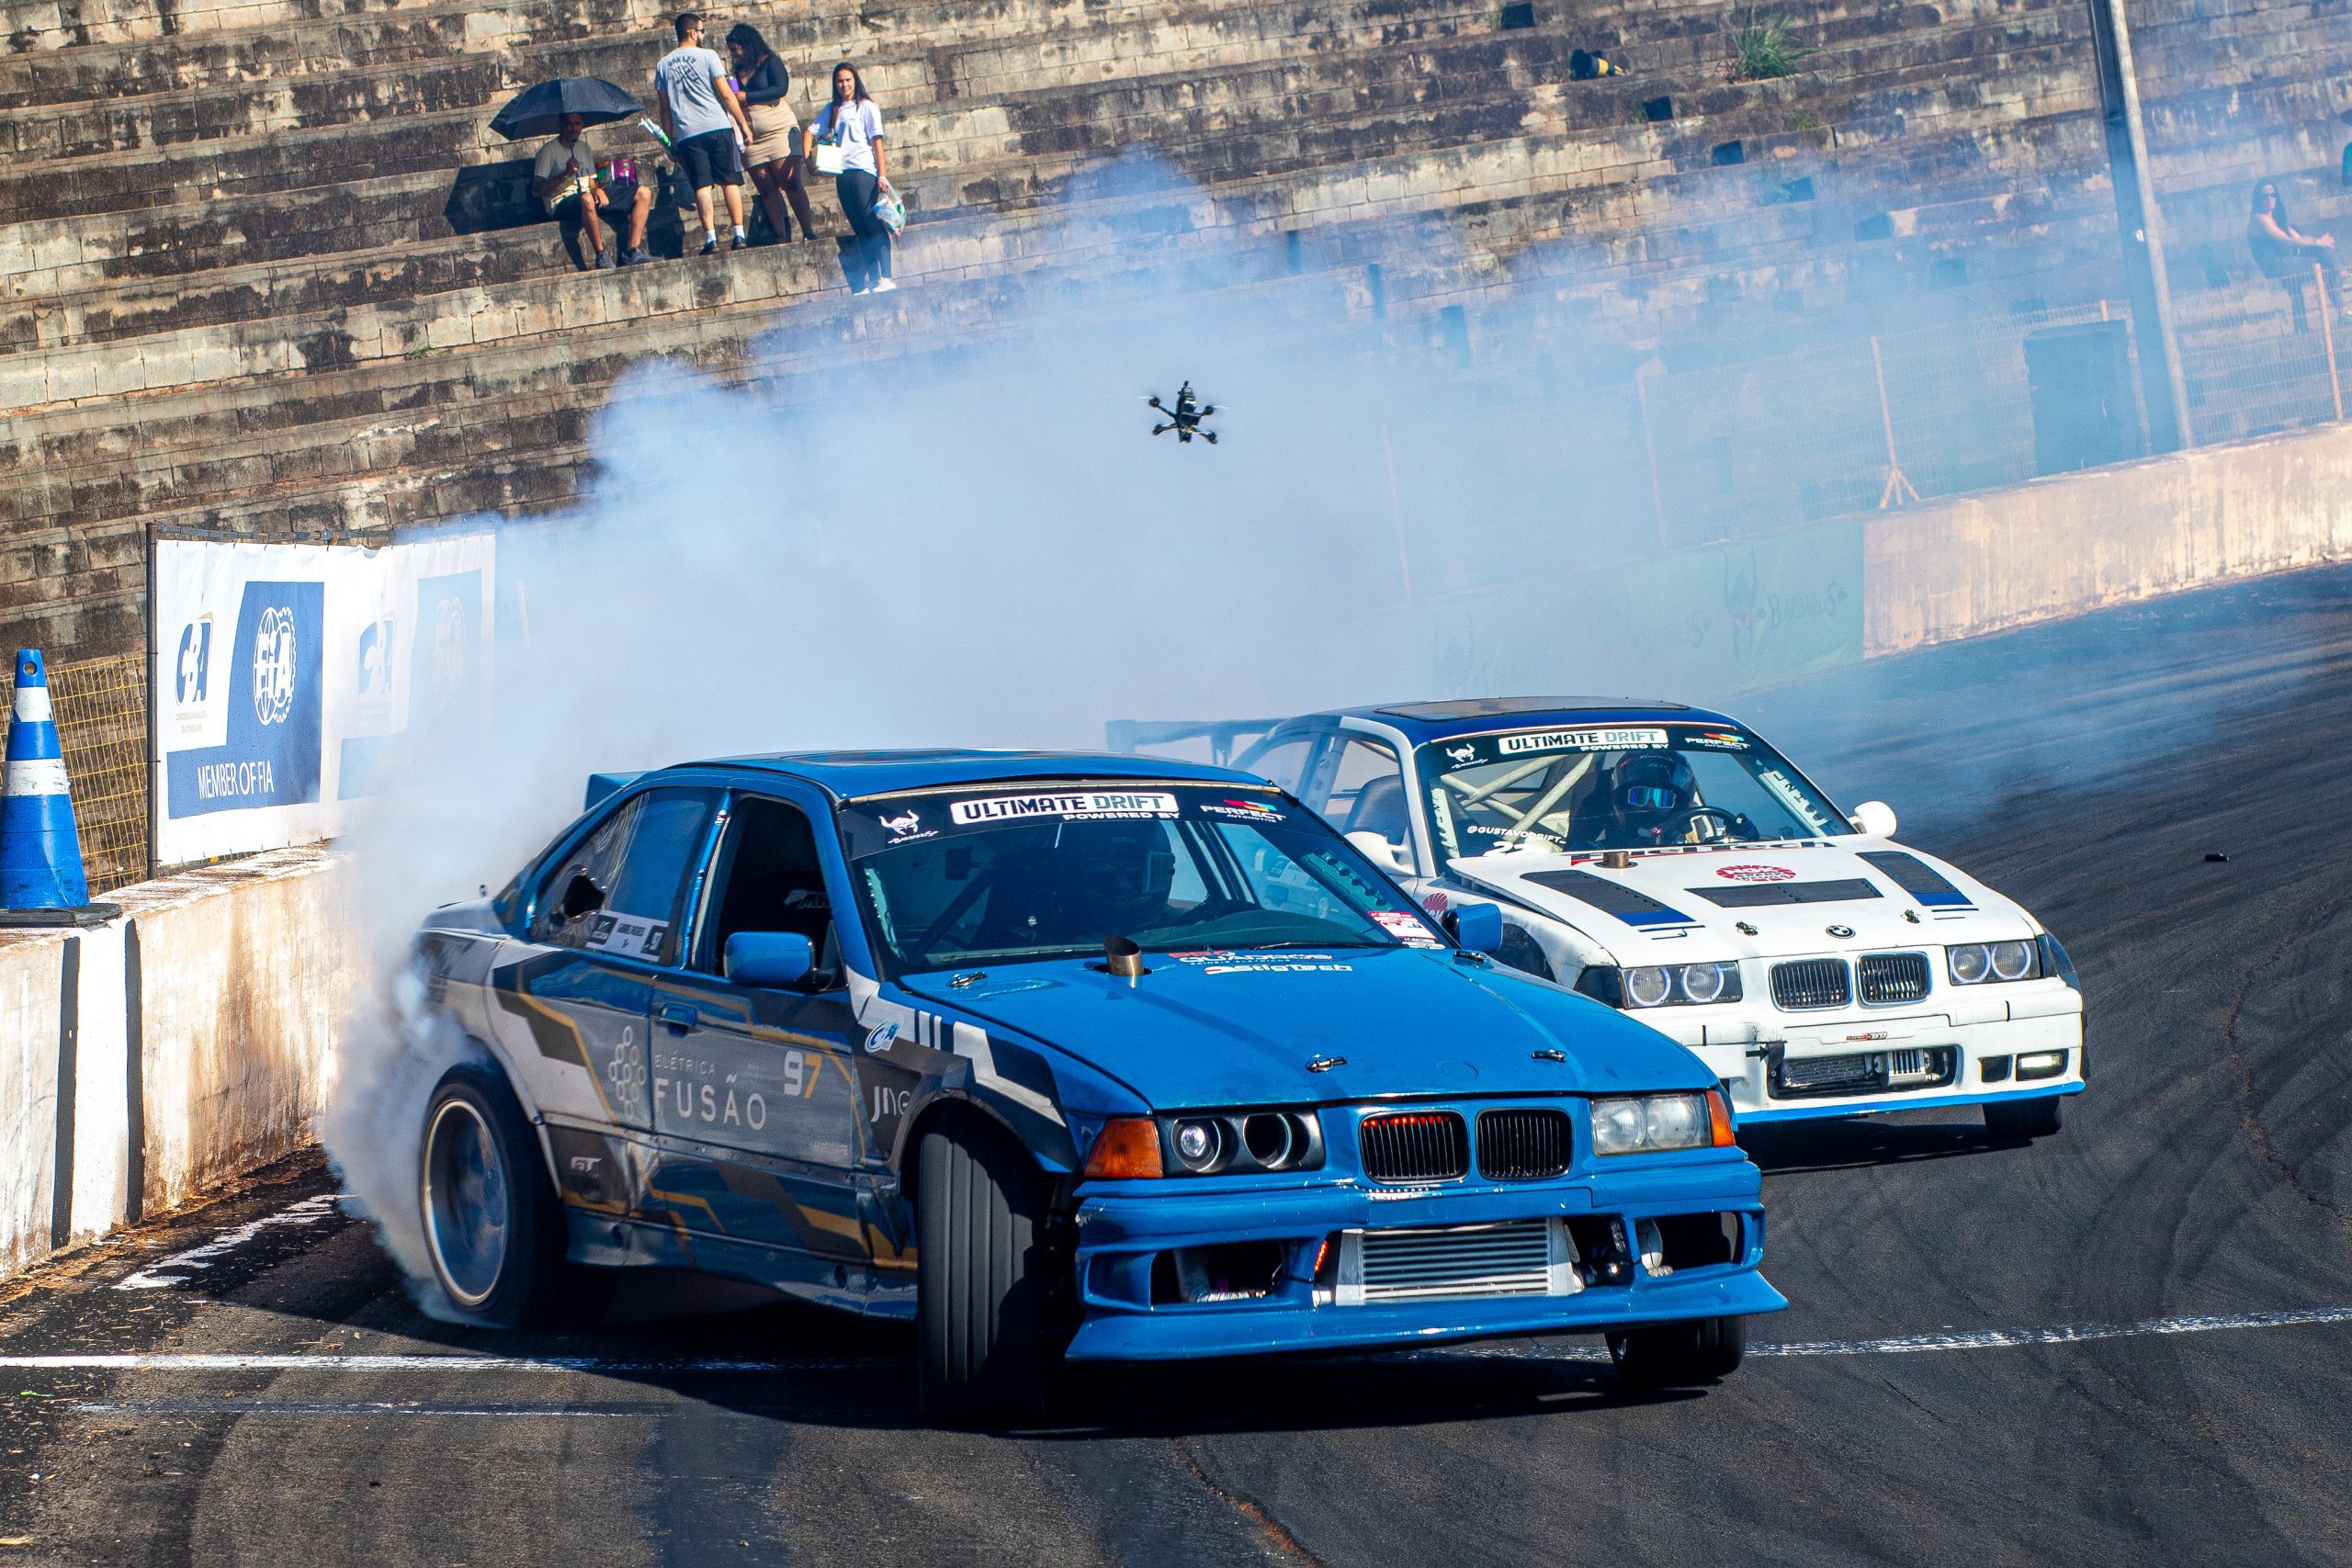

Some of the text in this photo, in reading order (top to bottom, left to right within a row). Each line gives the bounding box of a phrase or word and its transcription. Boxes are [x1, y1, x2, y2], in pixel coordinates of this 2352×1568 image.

[1508, 731, 1658, 750] ULTIMATE DRIFT
[198, 761, 275, 799] MEMBER OF FIA
[964, 795, 1164, 819] ULTIMATE DRIFT
[1062, 813, 1153, 821] POWERED
[1200, 806, 1286, 821] PERFECT
[784, 1050, 823, 1100] 97
[653, 1073, 766, 1131] FUSÃO
